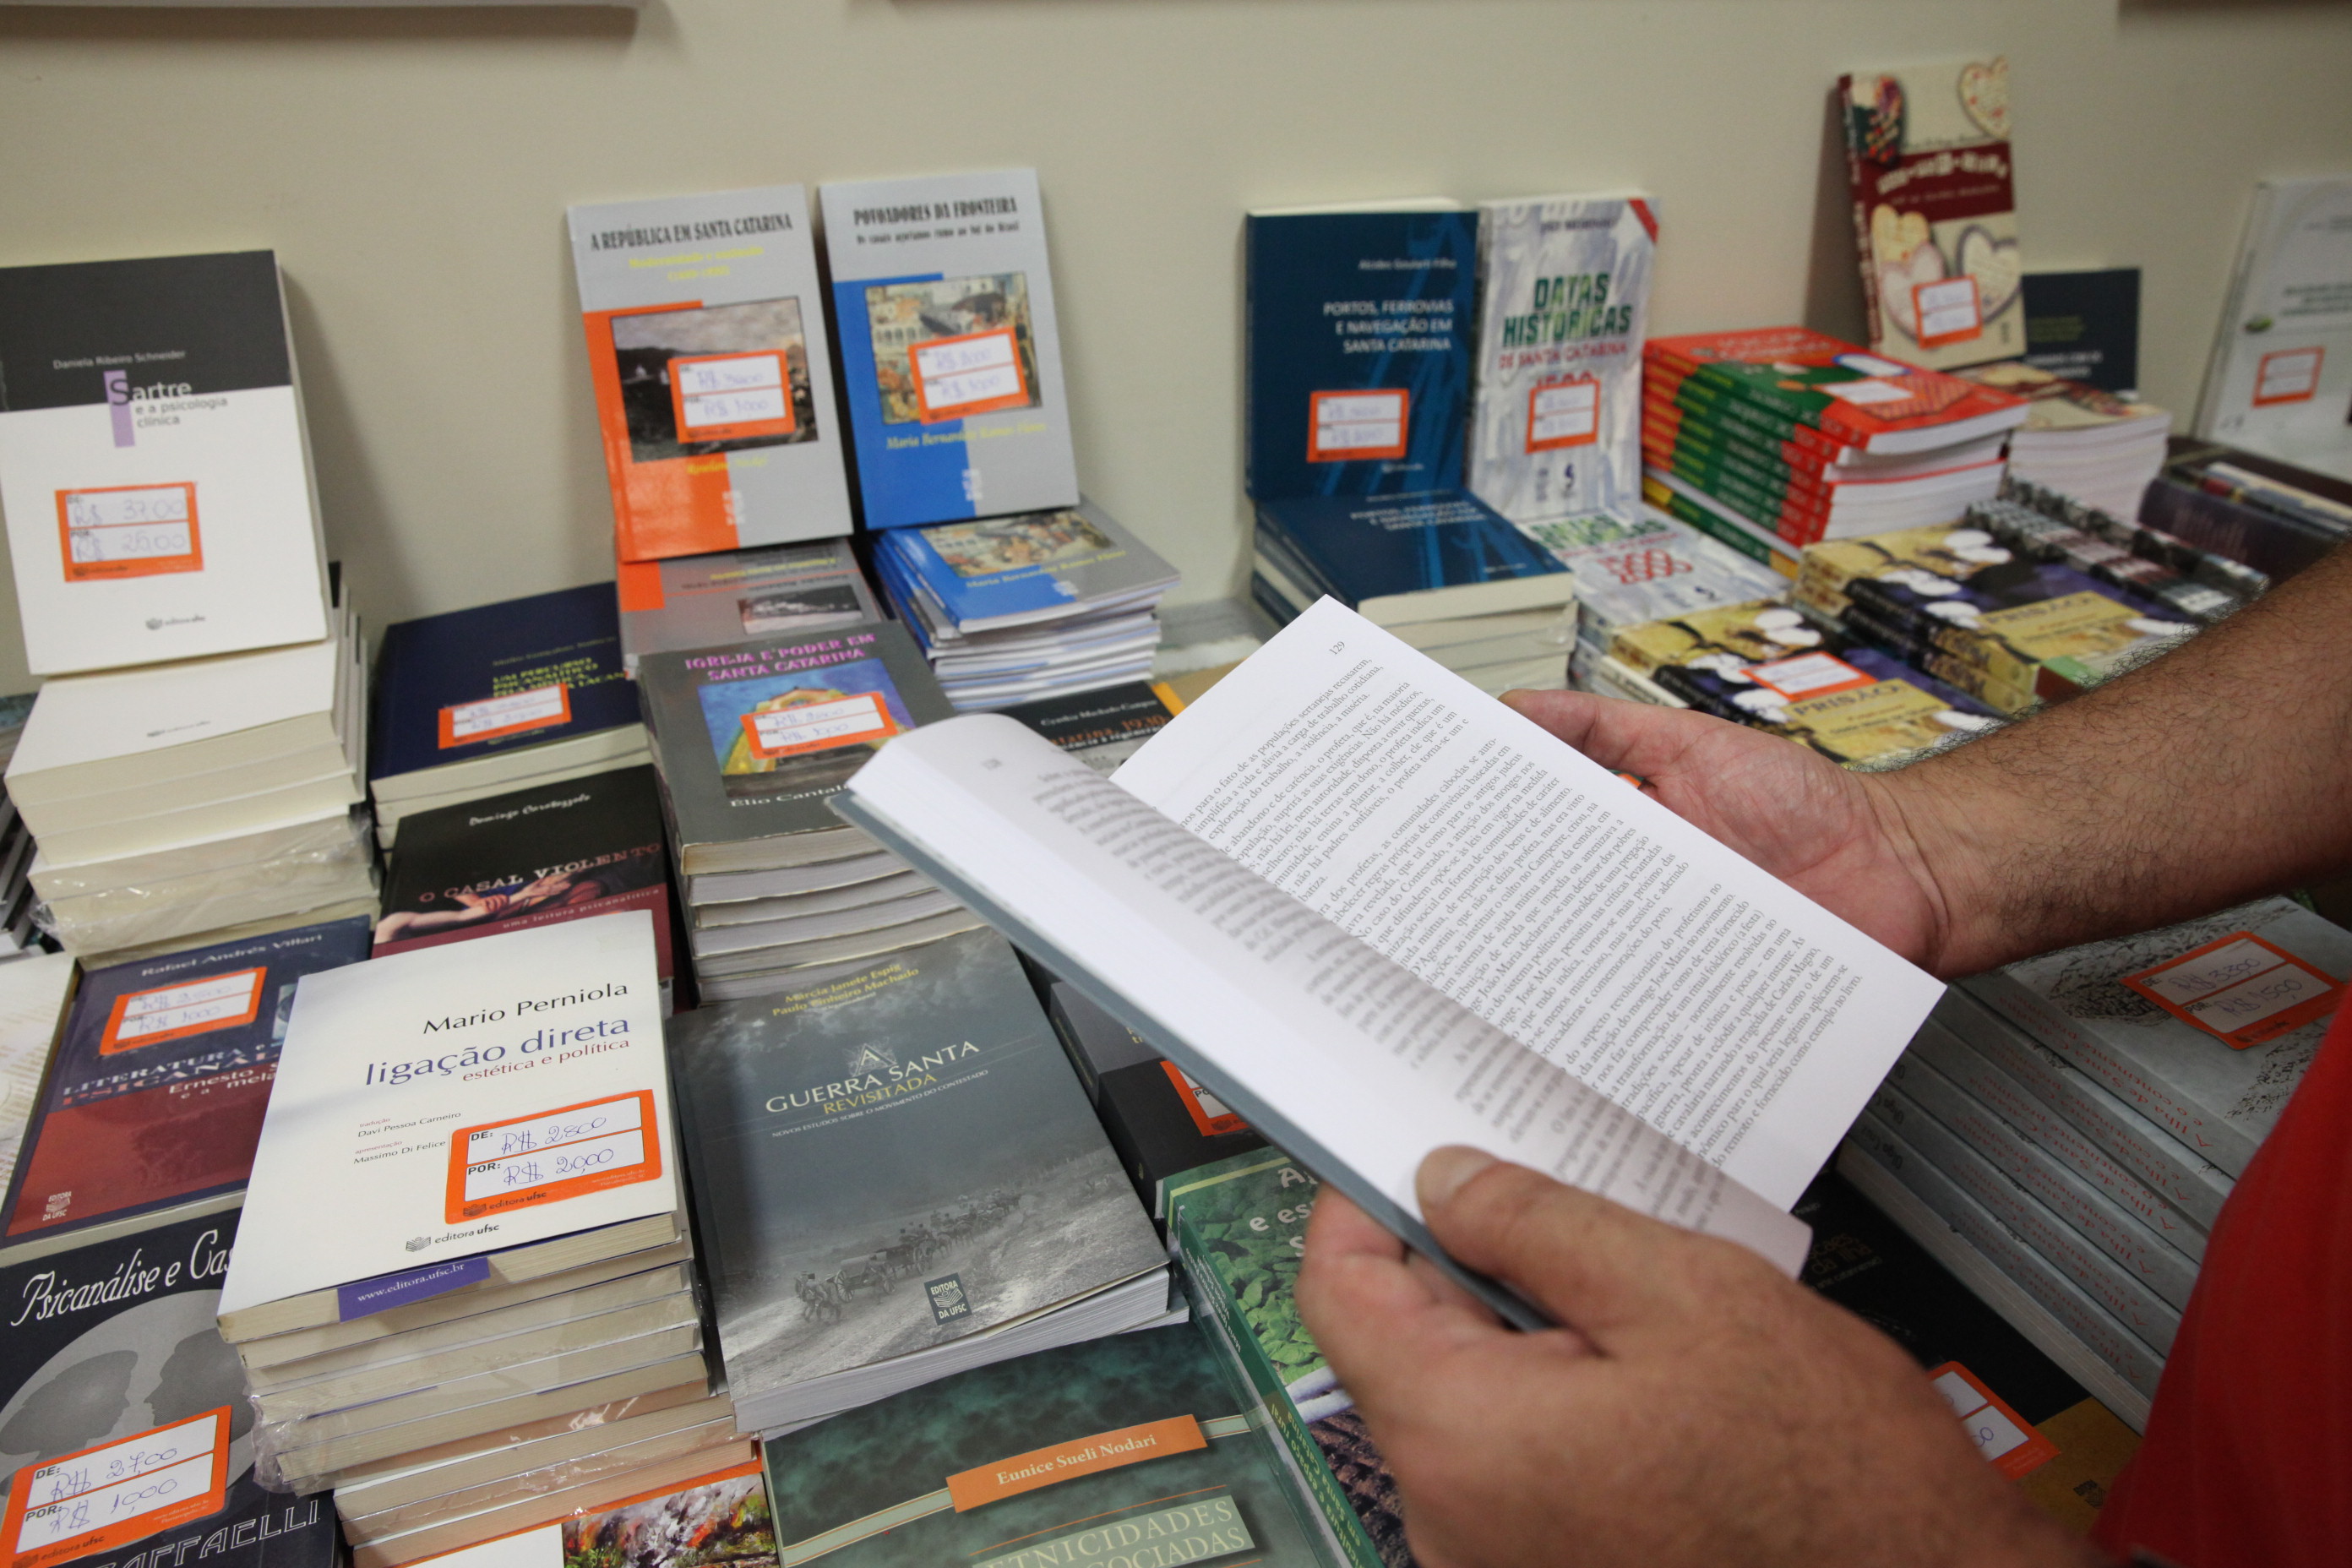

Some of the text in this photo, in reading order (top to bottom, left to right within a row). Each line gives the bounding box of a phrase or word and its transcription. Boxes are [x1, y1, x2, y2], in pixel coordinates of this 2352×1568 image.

[934, 202, 950, 220] DA
[954, 197, 1017, 217] FRONTEIRA
[591, 213, 793, 251] A REPÚBLICA EM SANTA CATARINA
[1534, 272, 1609, 309] DATAS
[1381, 298, 1454, 315] FERROVIAS
[1335, 317, 1453, 335] E NAVEGAÇÃO EM
[1343, 338, 1451, 353] SANTA CATARINA
[52, 350, 186, 370] Daniela Ribeiro Schneider
[110, 379, 192, 405] Sartre
[135, 396, 228, 414] e a psicologia
[685, 634, 876, 670] IGREJA E PODER EM
[1328, 640, 1345, 656] 129
[707, 649, 865, 681] SANTA CATARINA
[731, 795, 770, 807] Elio
[1372, 906, 1391, 926] caso
[1389, 893, 1403, 906] do
[1400, 849, 1450, 893] Contestado,
[1452, 814, 1481, 843] atuação
[1478, 800, 1495, 814] dos
[1493, 774, 1522, 802] monges
[1520, 761, 1535, 776] nos
[419, 843, 662, 902] O CASAL VIOLENTO
[503, 920, 528, 928] uma
[533, 908, 574, 923] leitura
[141, 959, 198, 977] Rafael
[202, 945, 267, 963] Andrés
[830, 974, 868, 994] Janete
[870, 962, 902, 980] Espig
[1840, 976, 1863, 996] livro.
[2142, 977, 2162, 988] DE:
[772, 967, 920, 1016] Paulo Pinheiro Machado
[1834, 994, 1847, 1008] no
[422, 983, 629, 1034] Mario Perniola
[2183, 1001, 2212, 1014] POR:
[1809, 1006, 1838, 1042] exemplo
[2000, 997, 2070, 1050] Catarina
[2023, 1002, 2078, 1040] próximo
[366, 1019, 630, 1086] ligação direta
[462, 1038, 629, 1081] estética e política
[860, 1049, 880, 1065] A
[1790, 1041, 1811, 1067] como
[63, 1048, 247, 1096] LITERATURA
[168, 1069, 254, 1095] Ernesto
[765, 1041, 980, 1113] GUERRA SANTA
[2074, 1050, 2123, 1088] Santa
[2082, 1043, 2173, 1105] continente
[823, 1073, 937, 1115] REVISITADA
[1755, 1066, 1793, 1110] fornecido
[2129, 1088, 2150, 1103] de
[772, 1127, 802, 1138] NOVOS
[803, 1117, 839, 1130] ESTUDOS
[840, 1109, 864, 1122] SOBRE
[874, 1092, 923, 1113] MOVIMENTO
[924, 1088, 936, 1097] DO
[938, 1070, 988, 1092] CONTESTADO
[358, 1112, 461, 1138] Davi Pessoa Carneiro
[359, 1117, 391, 1128] tradução
[2153, 1105, 2189, 1135] Ilha
[355, 1141, 402, 1155] apresentação
[471, 1130, 493, 1142] DE:
[1723, 1117, 1754, 1154] remoto
[353, 1140, 446, 1164] Massimo Di Felice
[467, 1162, 501, 1176] POR:
[47, 1191, 73, 1203] EDITORA
[489, 1190, 547, 1210] editora ufsc
[42, 1209, 68, 1222] DA UFSC
[1250, 1217, 1270, 1232] e
[435, 1222, 500, 1244] editora ufsc
[11, 1248, 161, 1326] Psicanálise
[165, 1261, 182, 1288] e
[357, 1264, 466, 1302] www.editora.ufsc.br
[930, 1280, 958, 1295] EDITORA
[938, 1304, 967, 1320] DA UFSC
[1271, 1403, 1318, 1490] espaço rural
[1288, 1411, 1320, 1475] Catarina
[35, 1465, 61, 1480] DE:
[995, 1435, 1157, 1485] Eunice Sueli Nodari
[1322, 1474, 1346, 1522] Santa
[24, 1505, 63, 1523] POR:
[41, 1533, 106, 1561] editora ufsc
[96, 1500, 320, 1568] AFFAELLI
